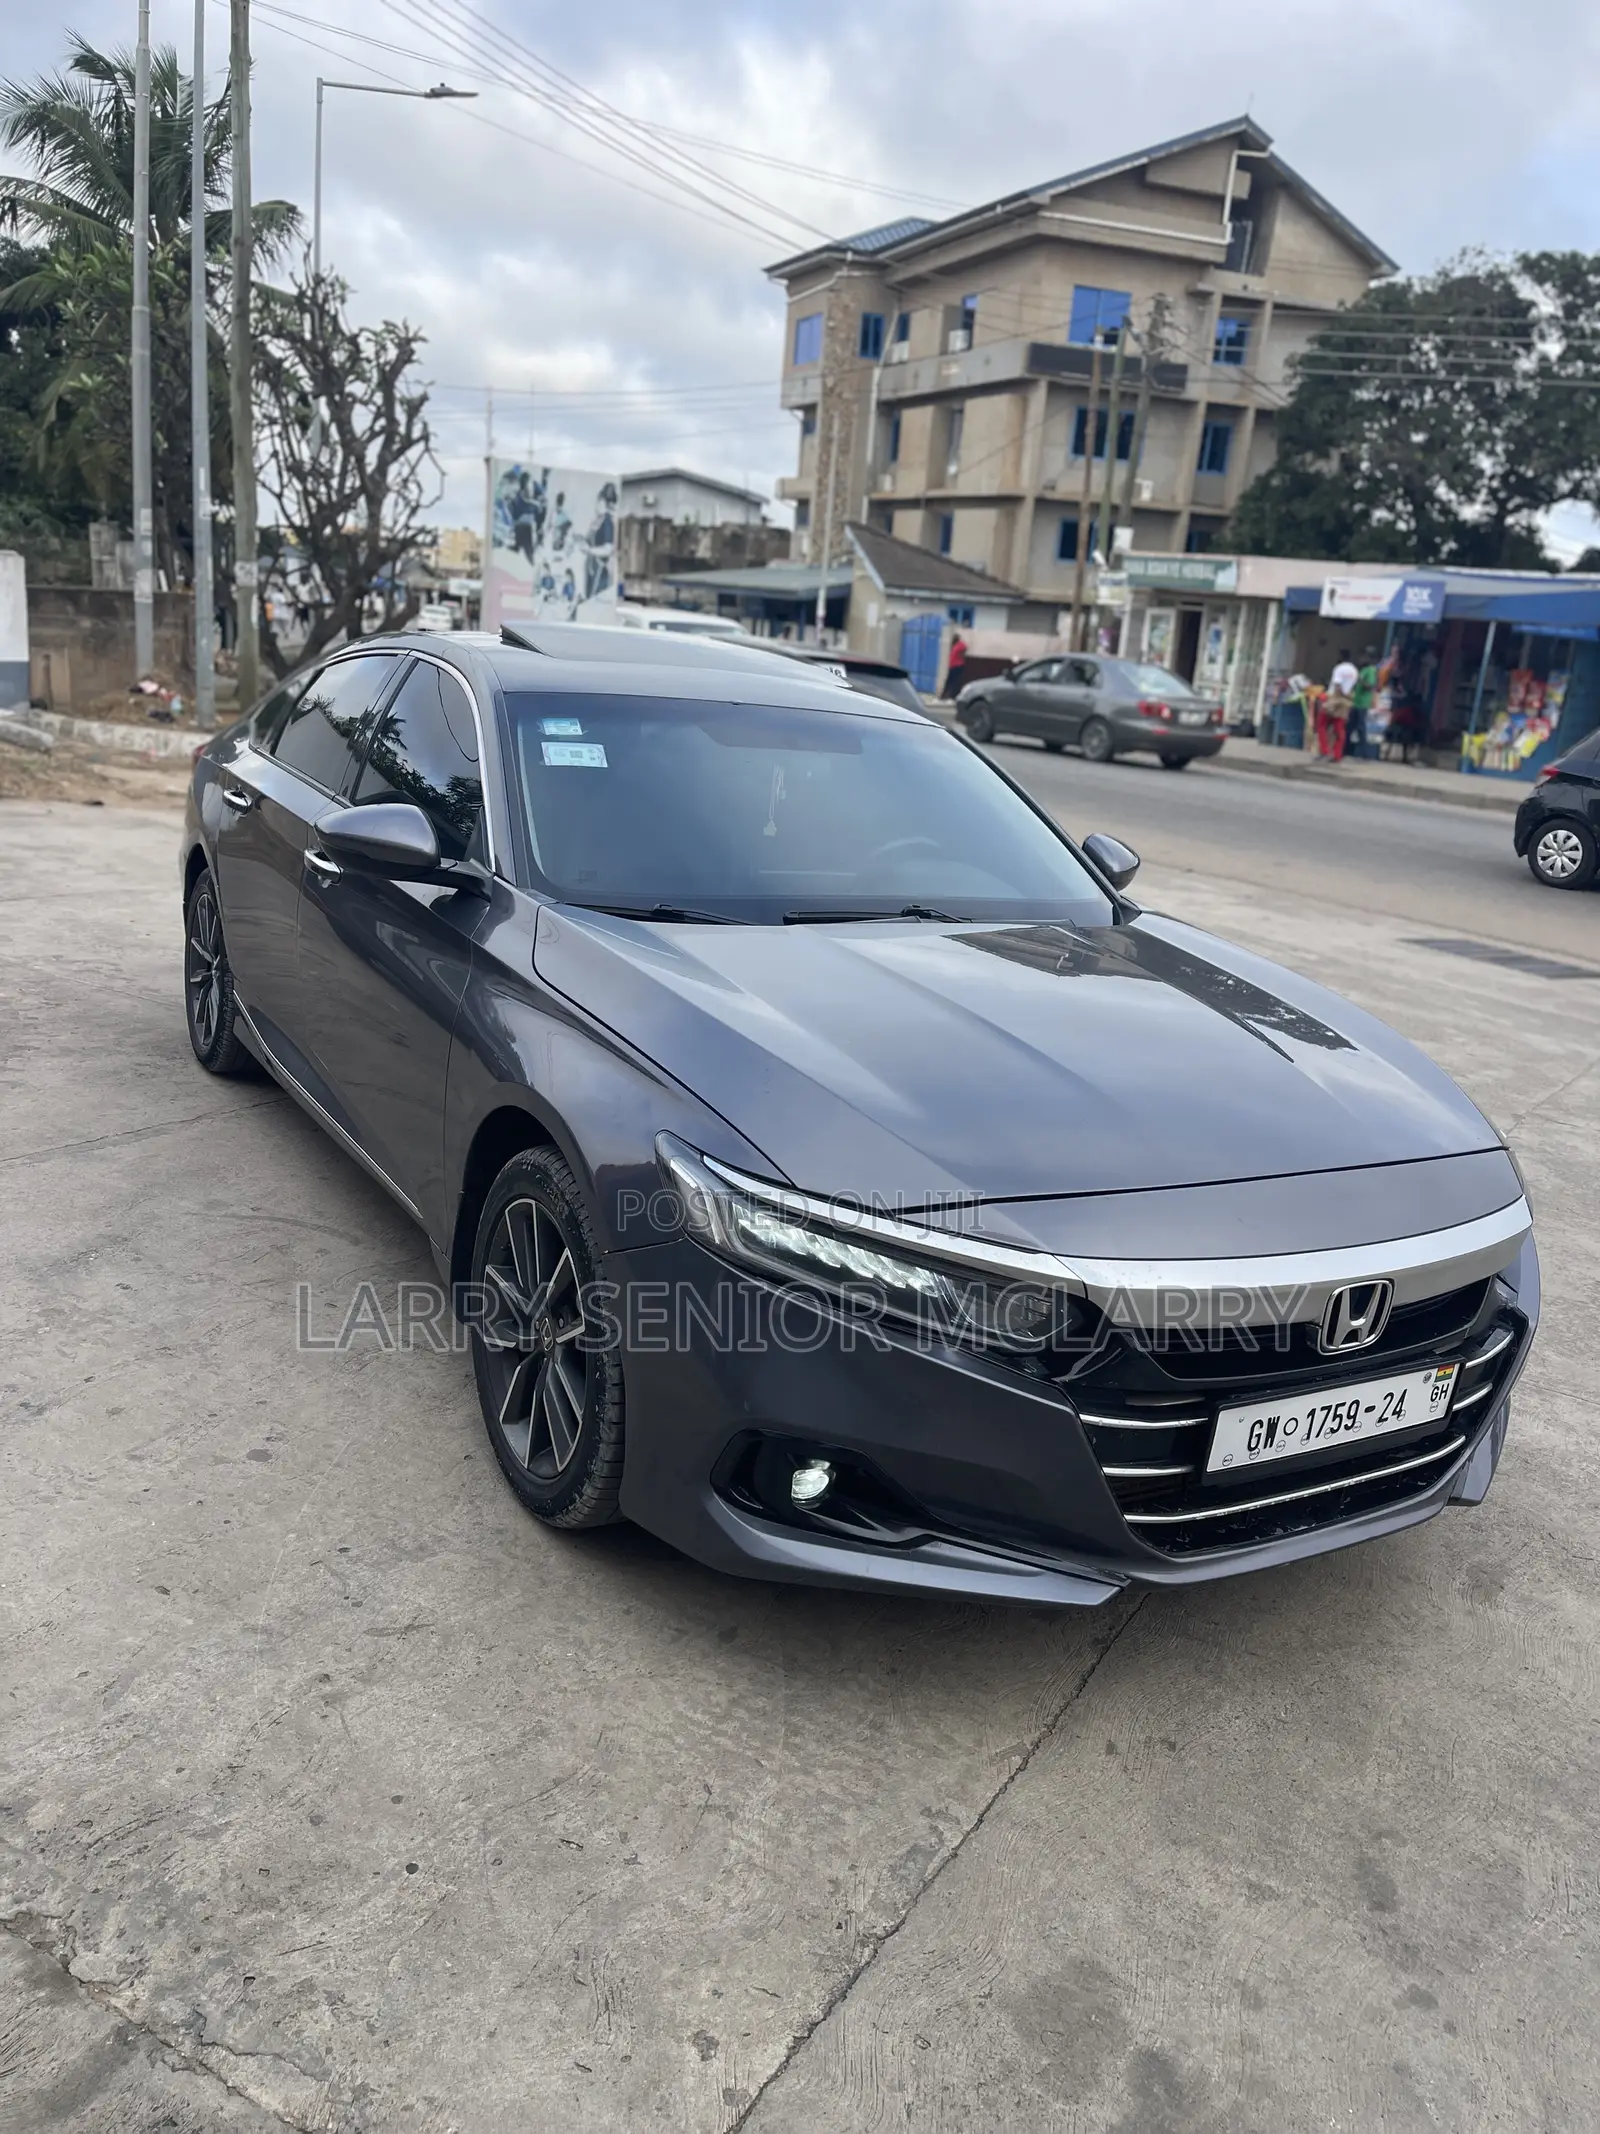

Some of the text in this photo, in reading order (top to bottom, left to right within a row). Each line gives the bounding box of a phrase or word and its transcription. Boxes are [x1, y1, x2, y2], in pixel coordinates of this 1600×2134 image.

[1430, 1383, 1450, 1402] GH
[1246, 1388, 1408, 1452] GW 1759-24
